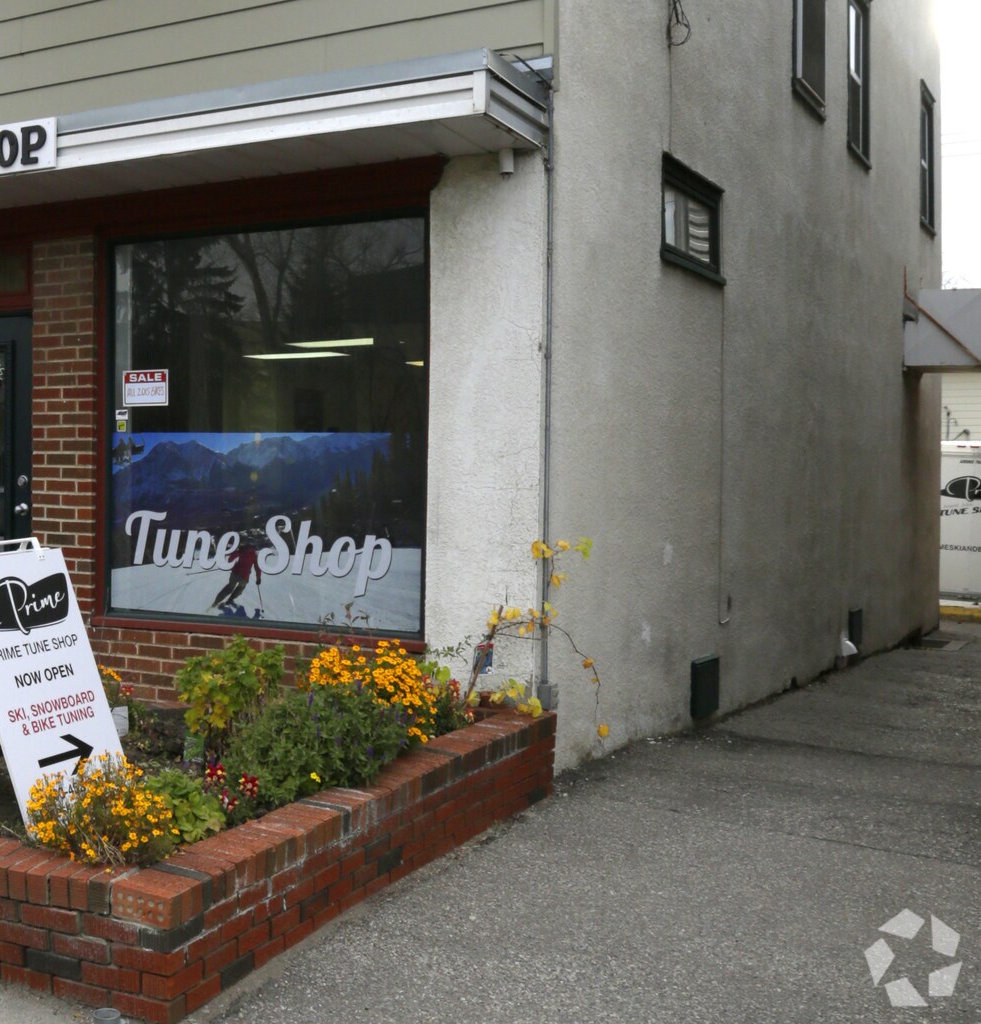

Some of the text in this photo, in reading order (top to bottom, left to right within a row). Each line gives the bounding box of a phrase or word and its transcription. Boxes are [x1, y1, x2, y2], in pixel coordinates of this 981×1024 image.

[129, 372, 162, 382] SALE
[125, 510, 393, 598] Tune Shop
[23, 639, 51, 657] TUNE
[52, 633, 79, 651] SHOP
[15, 663, 75, 688] NOW OPEN
[7, 691, 95, 724] SKI, SNOWBOARD
[22, 706, 94, 736] & BIKE TUNING
